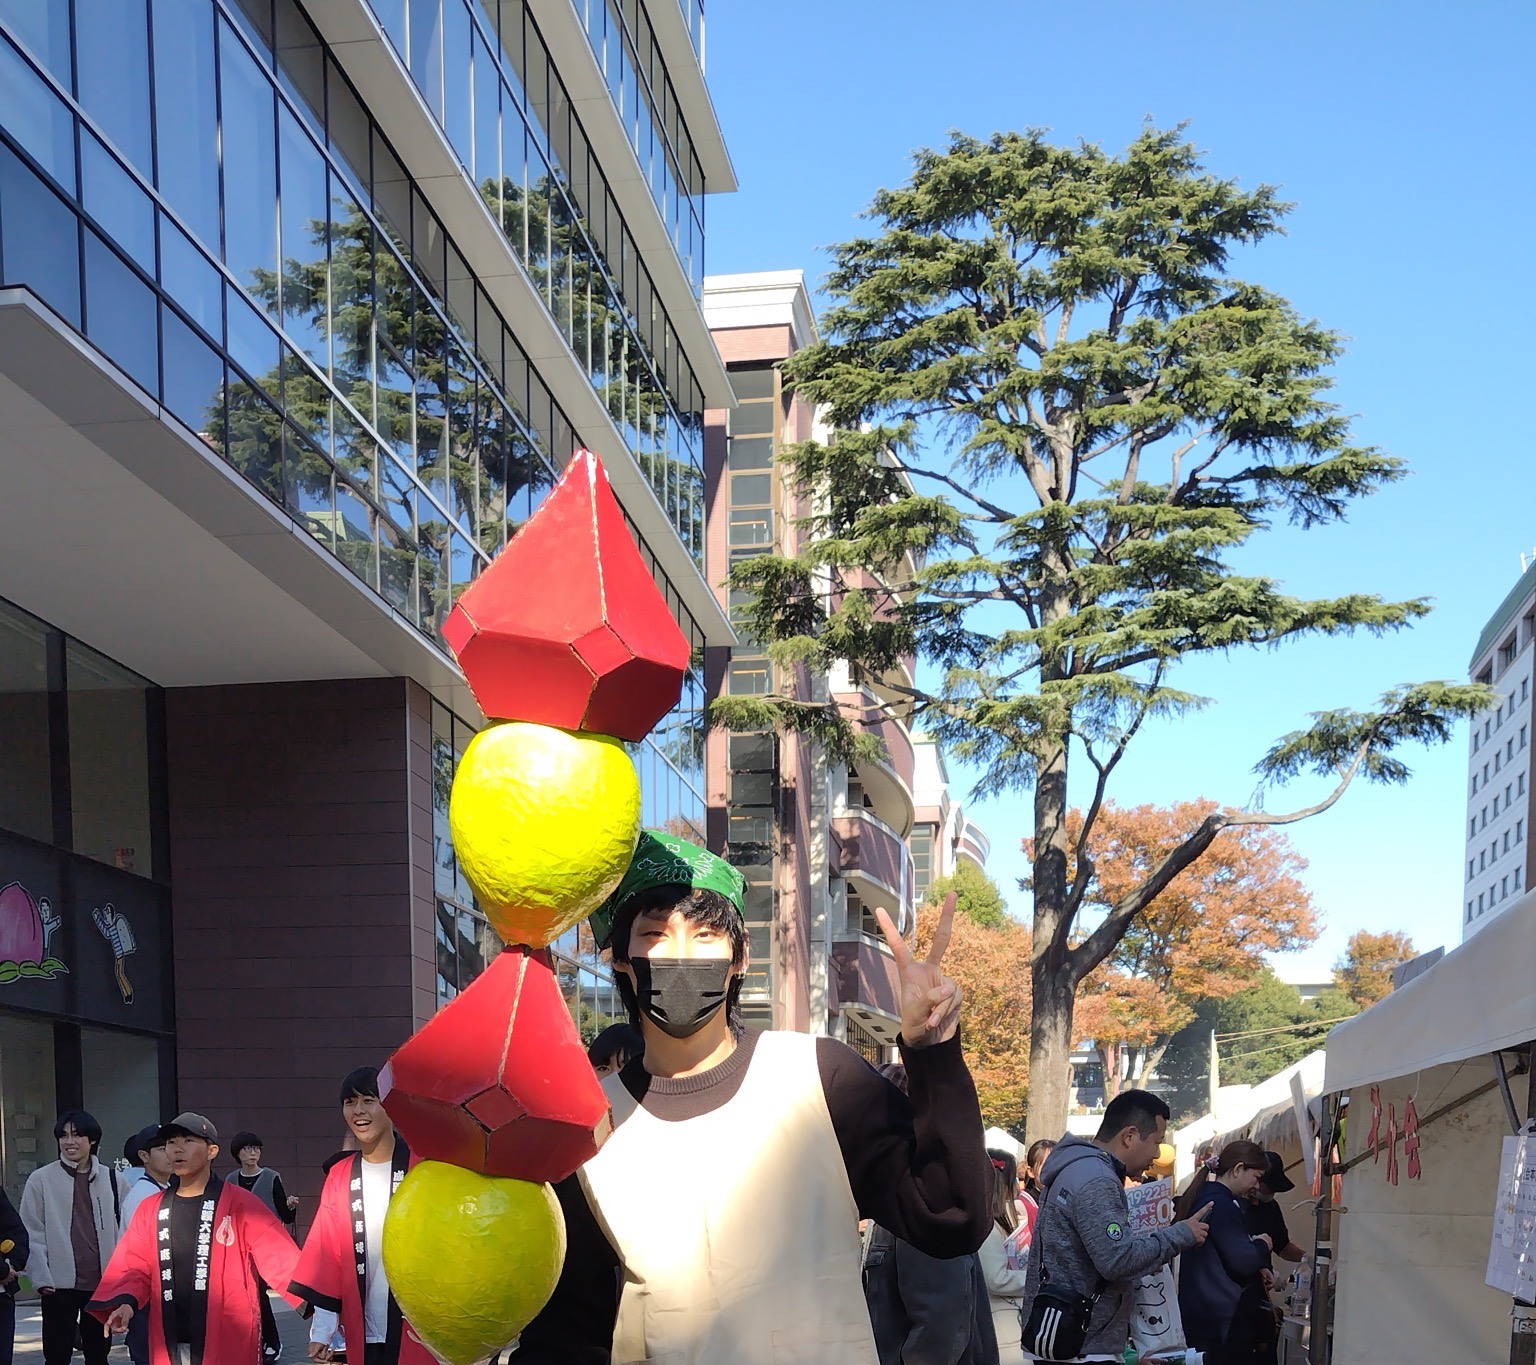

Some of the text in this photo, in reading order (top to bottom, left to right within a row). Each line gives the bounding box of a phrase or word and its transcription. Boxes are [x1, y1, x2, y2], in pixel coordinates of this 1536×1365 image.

[194, 1199, 215, 1291] 成蹊大学理工学部
